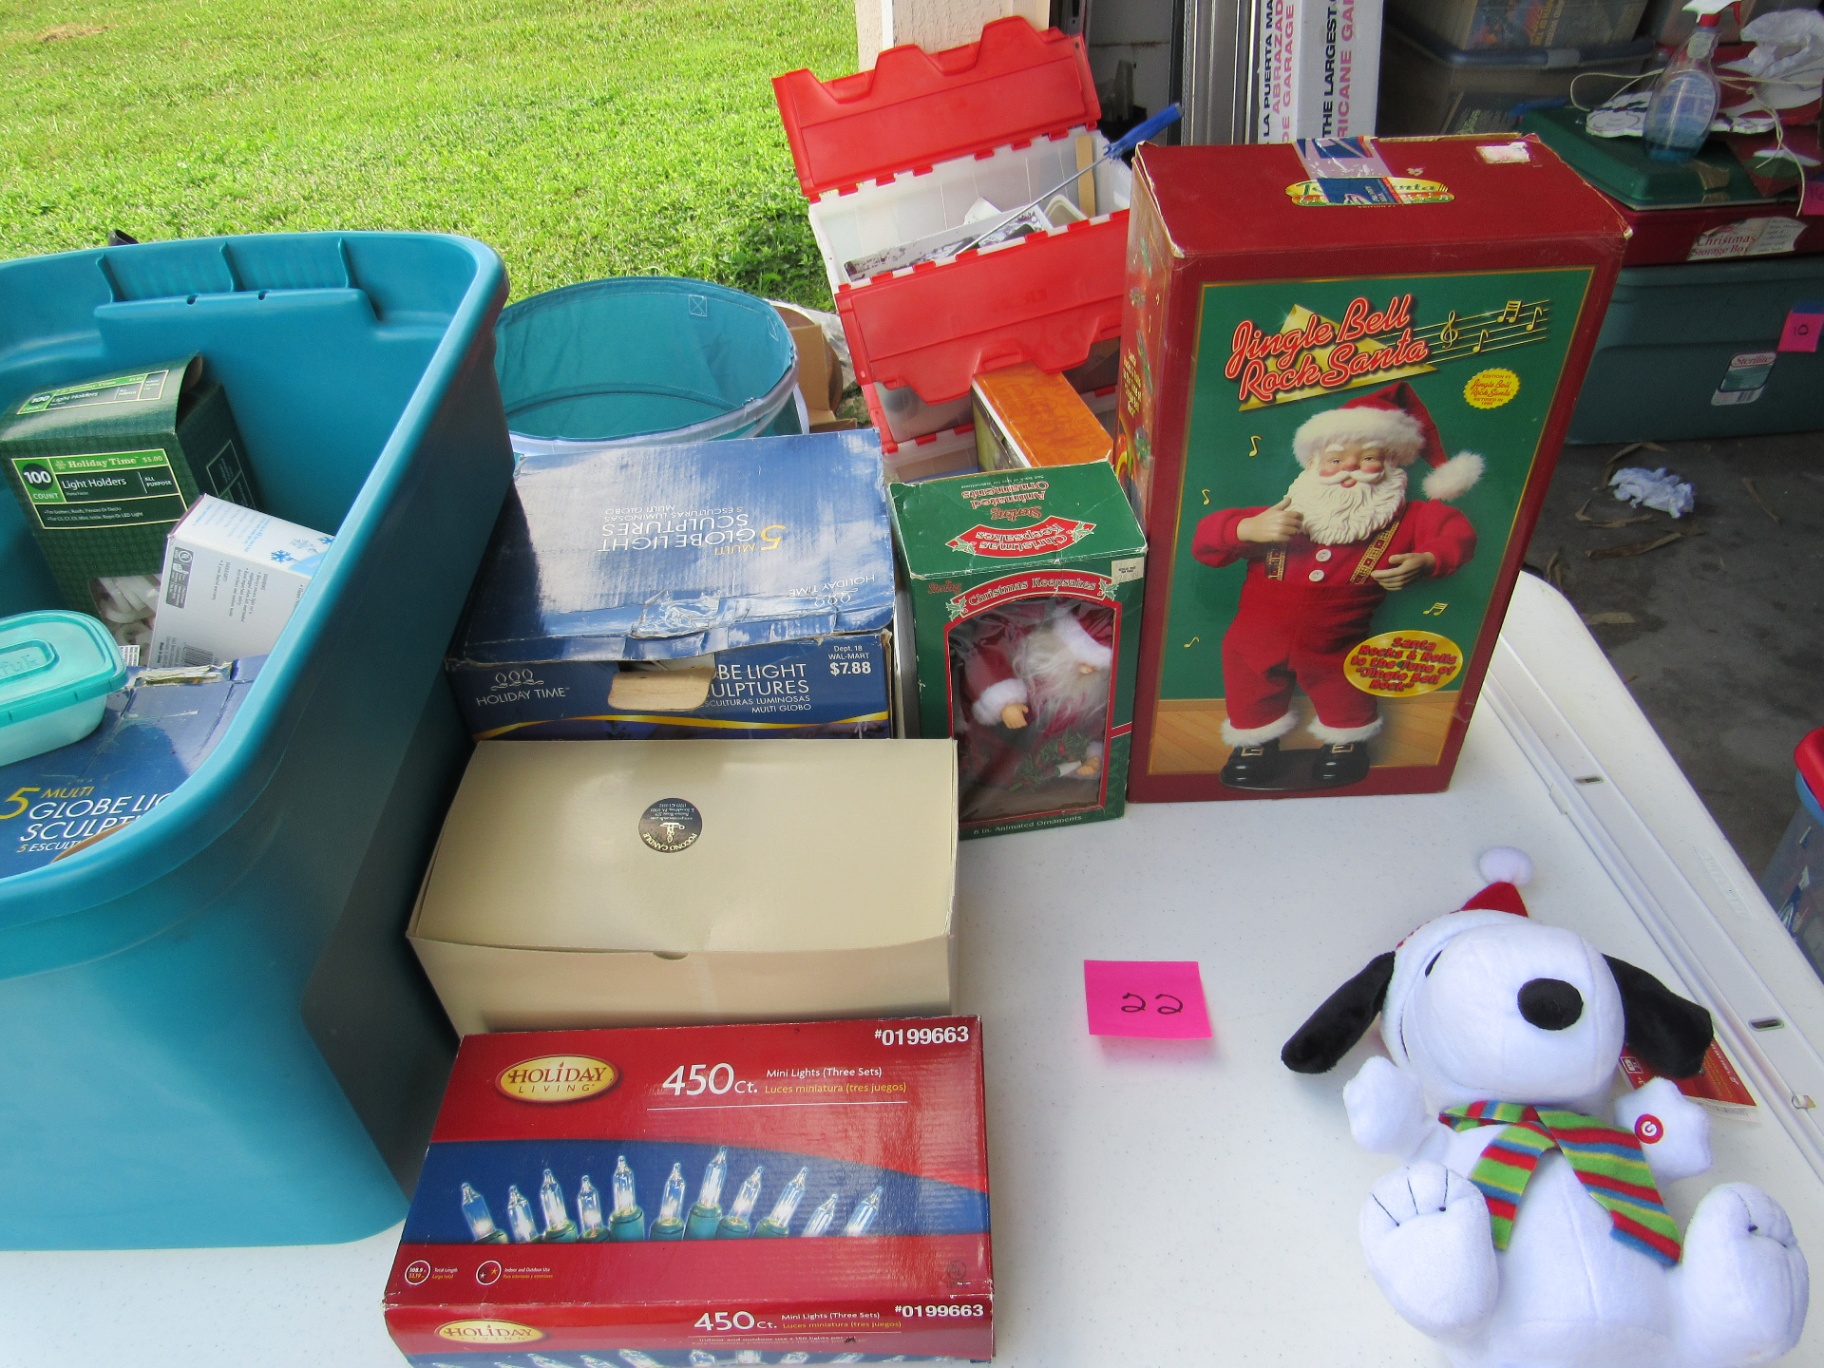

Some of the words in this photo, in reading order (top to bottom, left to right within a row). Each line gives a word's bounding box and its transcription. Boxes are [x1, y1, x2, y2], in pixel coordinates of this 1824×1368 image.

[1283, 4, 1294, 108] GARAGE
[1324, 7, 1337, 96] LARGEST
[1264, 34, 1272, 108] PUERTA
[1264, 114, 1269, 137] LA
[1322, 101, 1333, 138] THE
[1697, 236, 1757, 246] Christmas
[1225, 314, 1333, 378] Jingle
[1336, 294, 1413, 343] Bell
[1238, 354, 1321, 401] Rock
[1320, 327, 1429, 387] Santa
[67, 458, 108, 469] Holiday
[24, 471, 52, 484] 100
[61, 480, 87, 491] Light
[88, 477, 127, 488] Holders
[961, 481, 1049, 499] Ornaments
[970, 490, 1046, 510] Animated
[604, 512, 667, 522] LUMINOSAS
[646, 505, 675, 513] MULTI
[671, 507, 733, 518] ESCULTURAS
[602, 514, 749, 536] SCULPTURES
[975, 523, 1064, 543] Keepsakes
[598, 534, 669, 552] LIGHT
[674, 528, 756, 548] GLOBE
[760, 524, 786, 550] 5
[979, 534, 1067, 551] Christmas
[714, 543, 755, 555] MULTI
[789, 585, 818, 596] TIME
[822, 574, 875, 591] HOLIDAY
[968, 580, 1028, 606] Christmas
[1031, 577, 1097, 591] Keepsakes
[1391, 637, 1436, 650] Santa
[1359, 645, 1403, 658] Rocks
[1407, 650, 1417, 660] &
[1421, 652, 1457, 663] Rolls
[716, 664, 743, 680] BE
[748, 663, 807, 679] LIGHT
[829, 662, 872, 676] $7.88
[1351, 656, 1367, 666] to
[1370, 658, 1396, 669] the
[1400, 660, 1435, 673] Tune
[1438, 665, 1456, 675] of
[1410, 673, 1440, 684] Bell
[476, 690, 530, 707] HOLIDAY
[534, 687, 566, 698] TIME
[709, 680, 809, 698] ULPTURES
[756, 695, 811, 704] LUMINOSAS
[751, 705, 777, 714] MULTI
[779, 704, 812, 712] GLOBO
[40, 785, 95, 798] MULTI
[0, 787, 41, 820] 5
[29, 795, 132, 820] GLOBE
[20, 815, 142, 842] SCULPT
[995, 822, 1035, 832] Animated
[1036, 815, 1082, 826] Ornaments
[17, 844, 28, 853] 5
[643, 833, 668, 850] CANDLE
[670, 833, 698, 850] POCONO
[1121, 992, 1183, 1015] 22
[874, 1025, 969, 1046] #0199663
[507, 1062, 607, 1084] HOLIDAY
[766, 1069, 788, 1078] Mini
[791, 1068, 820, 1079] Lights
[823, 1067, 855, 1078] (Three
[858, 1067, 882, 1078] Sets)
[518, 1084, 590, 1094] LIVING
[765, 1085, 792, 1094] Luces
[796, 1084, 843, 1093] miniatura
[846, 1083, 868, 1093] (tres
[871, 1082, 907, 1093] juegos)
[803, 1313, 828, 1321] Lights
[894, 1304, 984, 1318] #0199663
[444, 1325, 533, 1338] HOLIDAY
